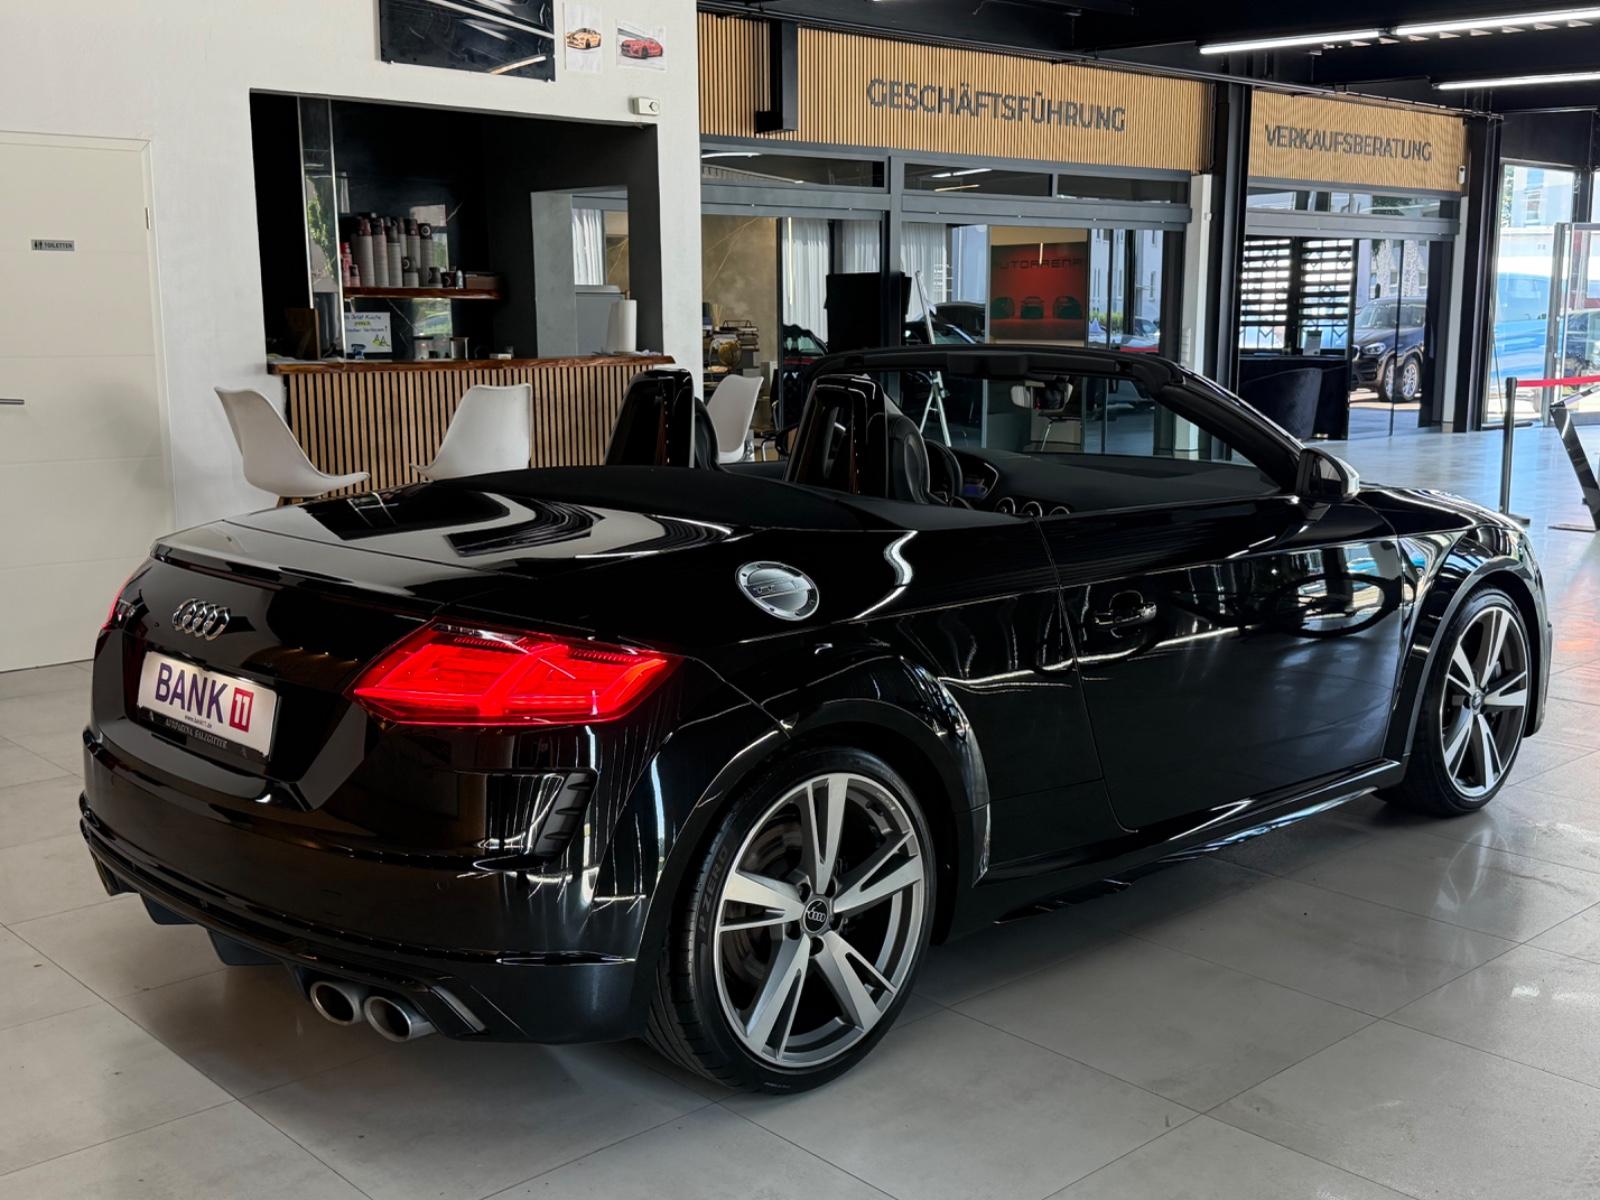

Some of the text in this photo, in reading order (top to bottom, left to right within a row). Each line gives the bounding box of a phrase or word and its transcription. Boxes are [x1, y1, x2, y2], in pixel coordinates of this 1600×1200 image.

[866, 78, 1126, 133] GESCHÄFTSFÜHRUNG
[1265, 123, 1433, 162] VERKAUFSBERATUNG
[44, 241, 73, 249] TOILETTEN
[155, 662, 229, 724] BANK
